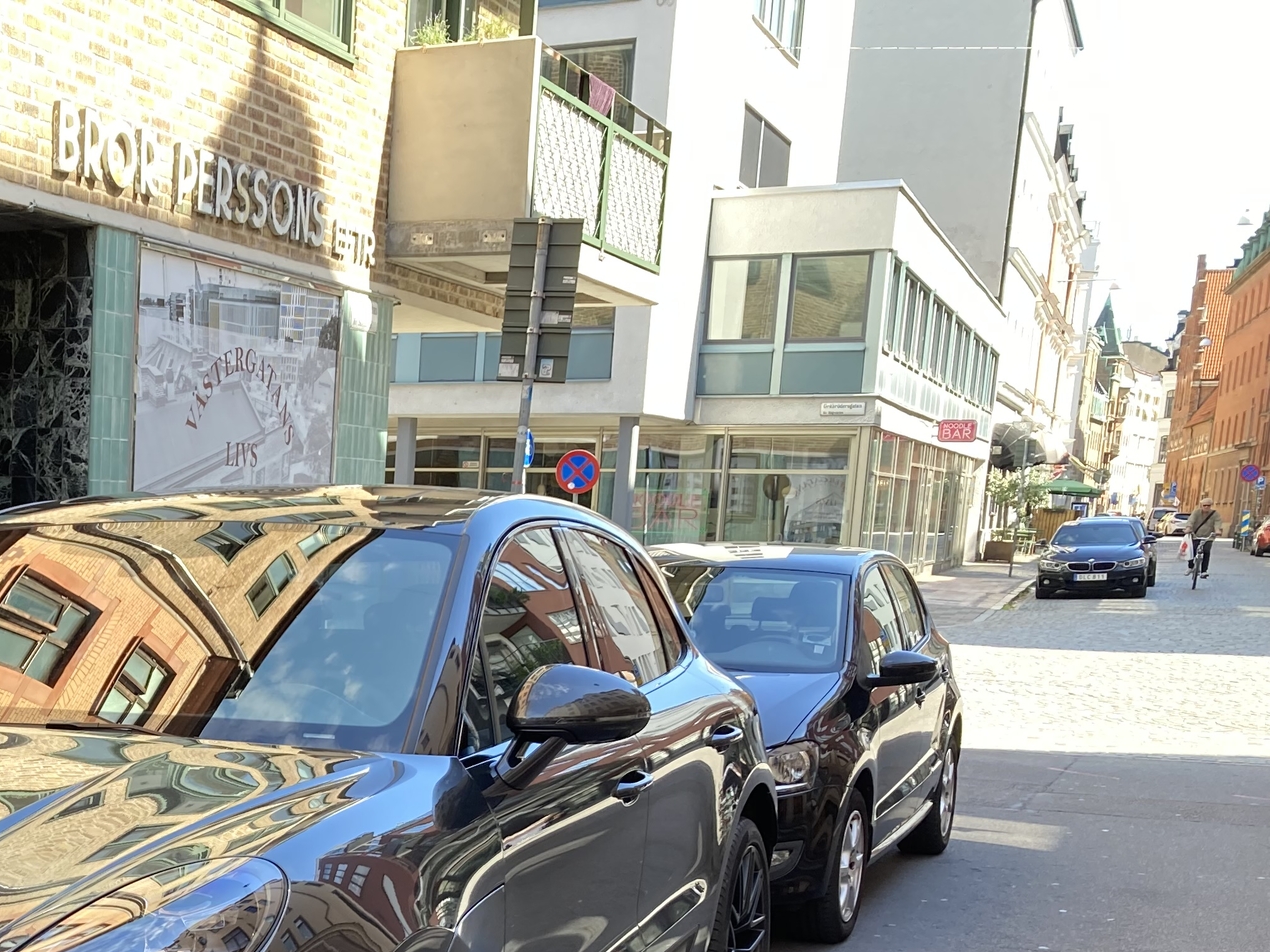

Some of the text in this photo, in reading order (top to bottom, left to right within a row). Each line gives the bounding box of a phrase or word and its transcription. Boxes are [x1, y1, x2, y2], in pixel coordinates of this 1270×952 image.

[52, 99, 159, 199] BROR
[173, 141, 326, 248] PERSSONS
[185, 346, 295, 446] VÄSTERGATANS
[941, 429, 972, 440] BAR
[942, 422, 973, 430] NOODLE
[224, 441, 258, 468] LIVS
